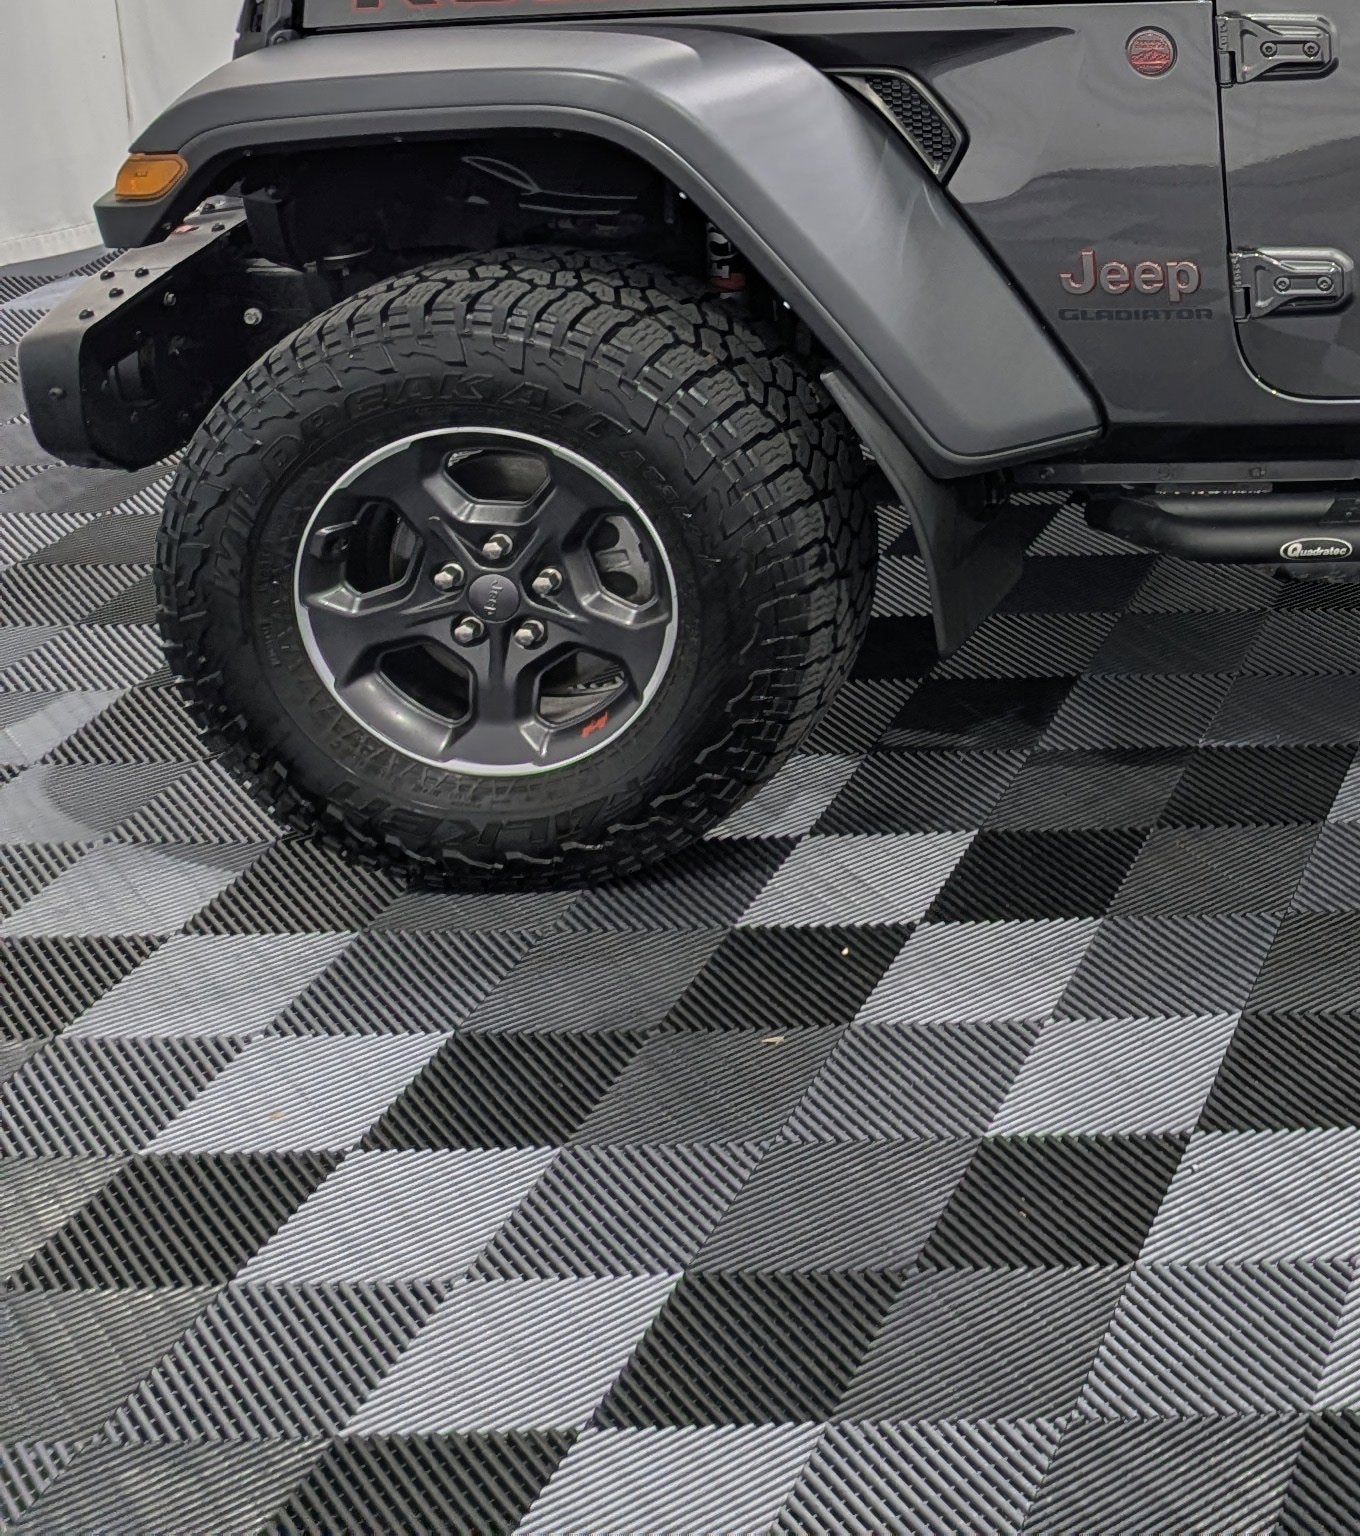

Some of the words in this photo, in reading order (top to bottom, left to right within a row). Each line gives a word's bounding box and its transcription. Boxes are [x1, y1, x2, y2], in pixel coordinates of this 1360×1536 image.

[1058, 248, 1200, 303] Jeep
[1057, 307, 1214, 322] GLADIATOR
[1286, 541, 1348, 559] Quadratec
